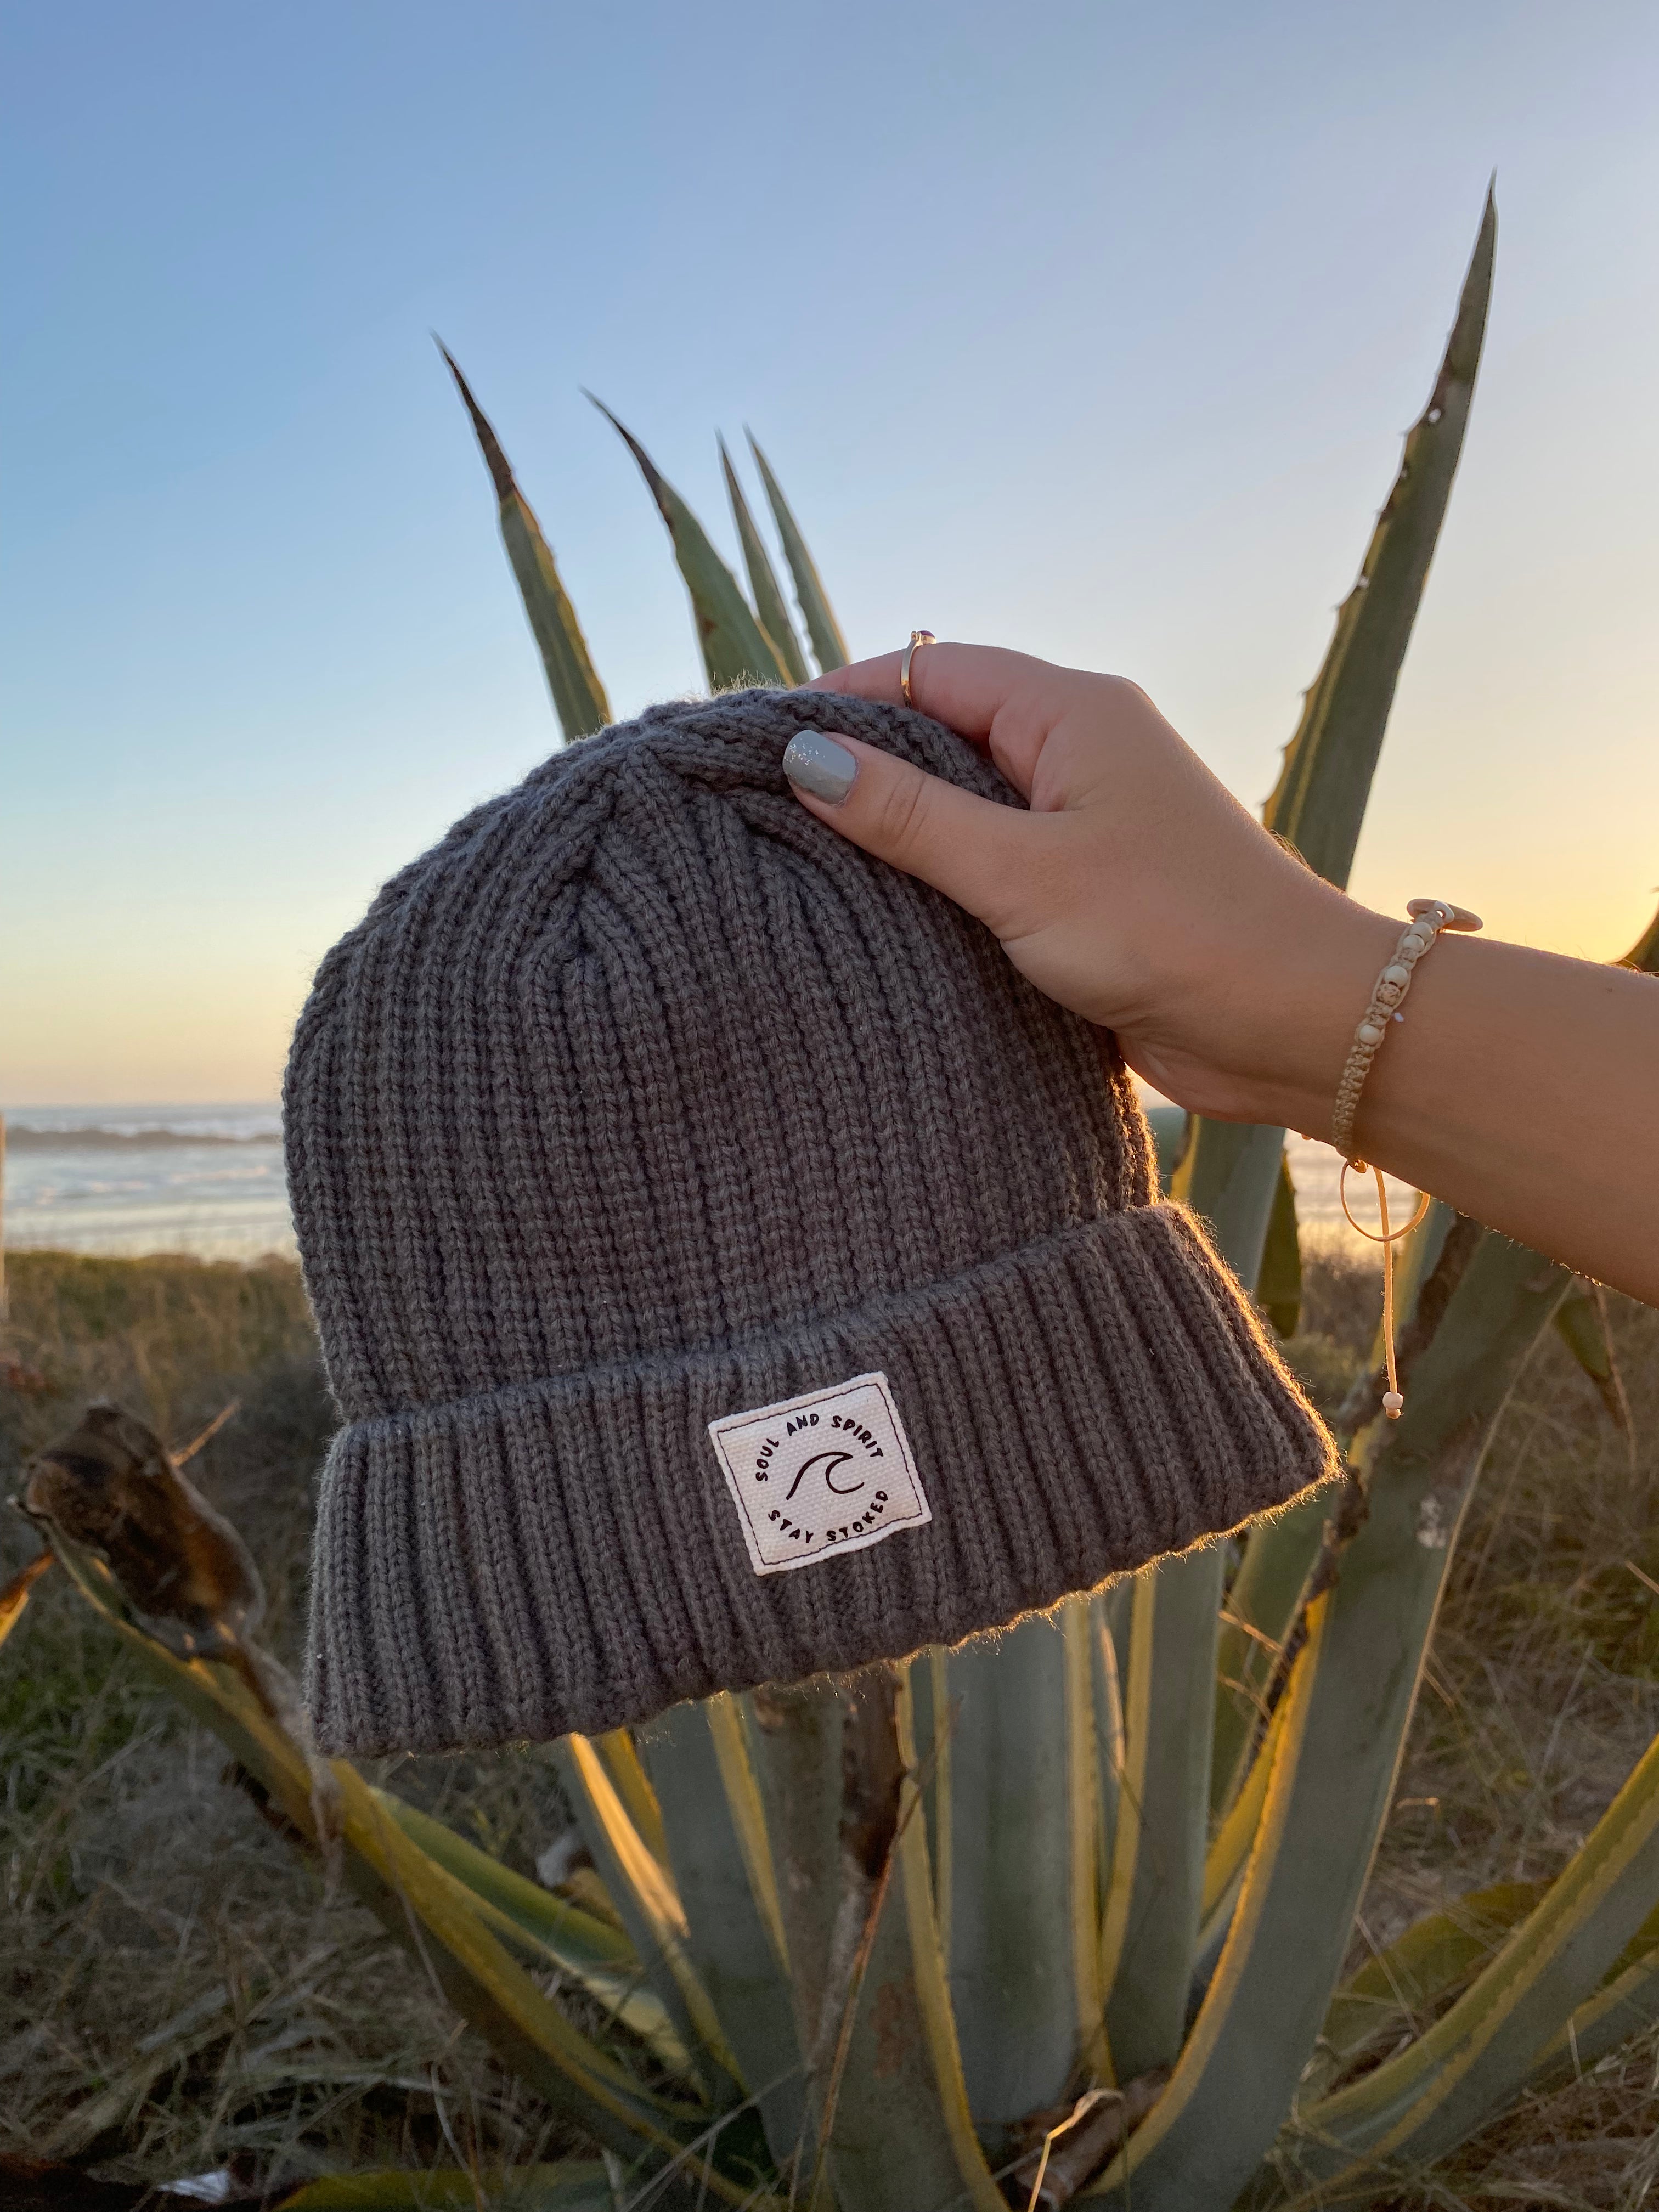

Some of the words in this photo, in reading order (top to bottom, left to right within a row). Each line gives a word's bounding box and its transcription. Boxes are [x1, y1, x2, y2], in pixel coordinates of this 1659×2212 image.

[755, 1438, 779, 1482] SOUL
[786, 1413, 819, 1436] AND
[831, 1415, 884, 1458] SPIRIT
[768, 1510, 814, 1543] STAY
[826, 1490, 888, 1541] STOKED
